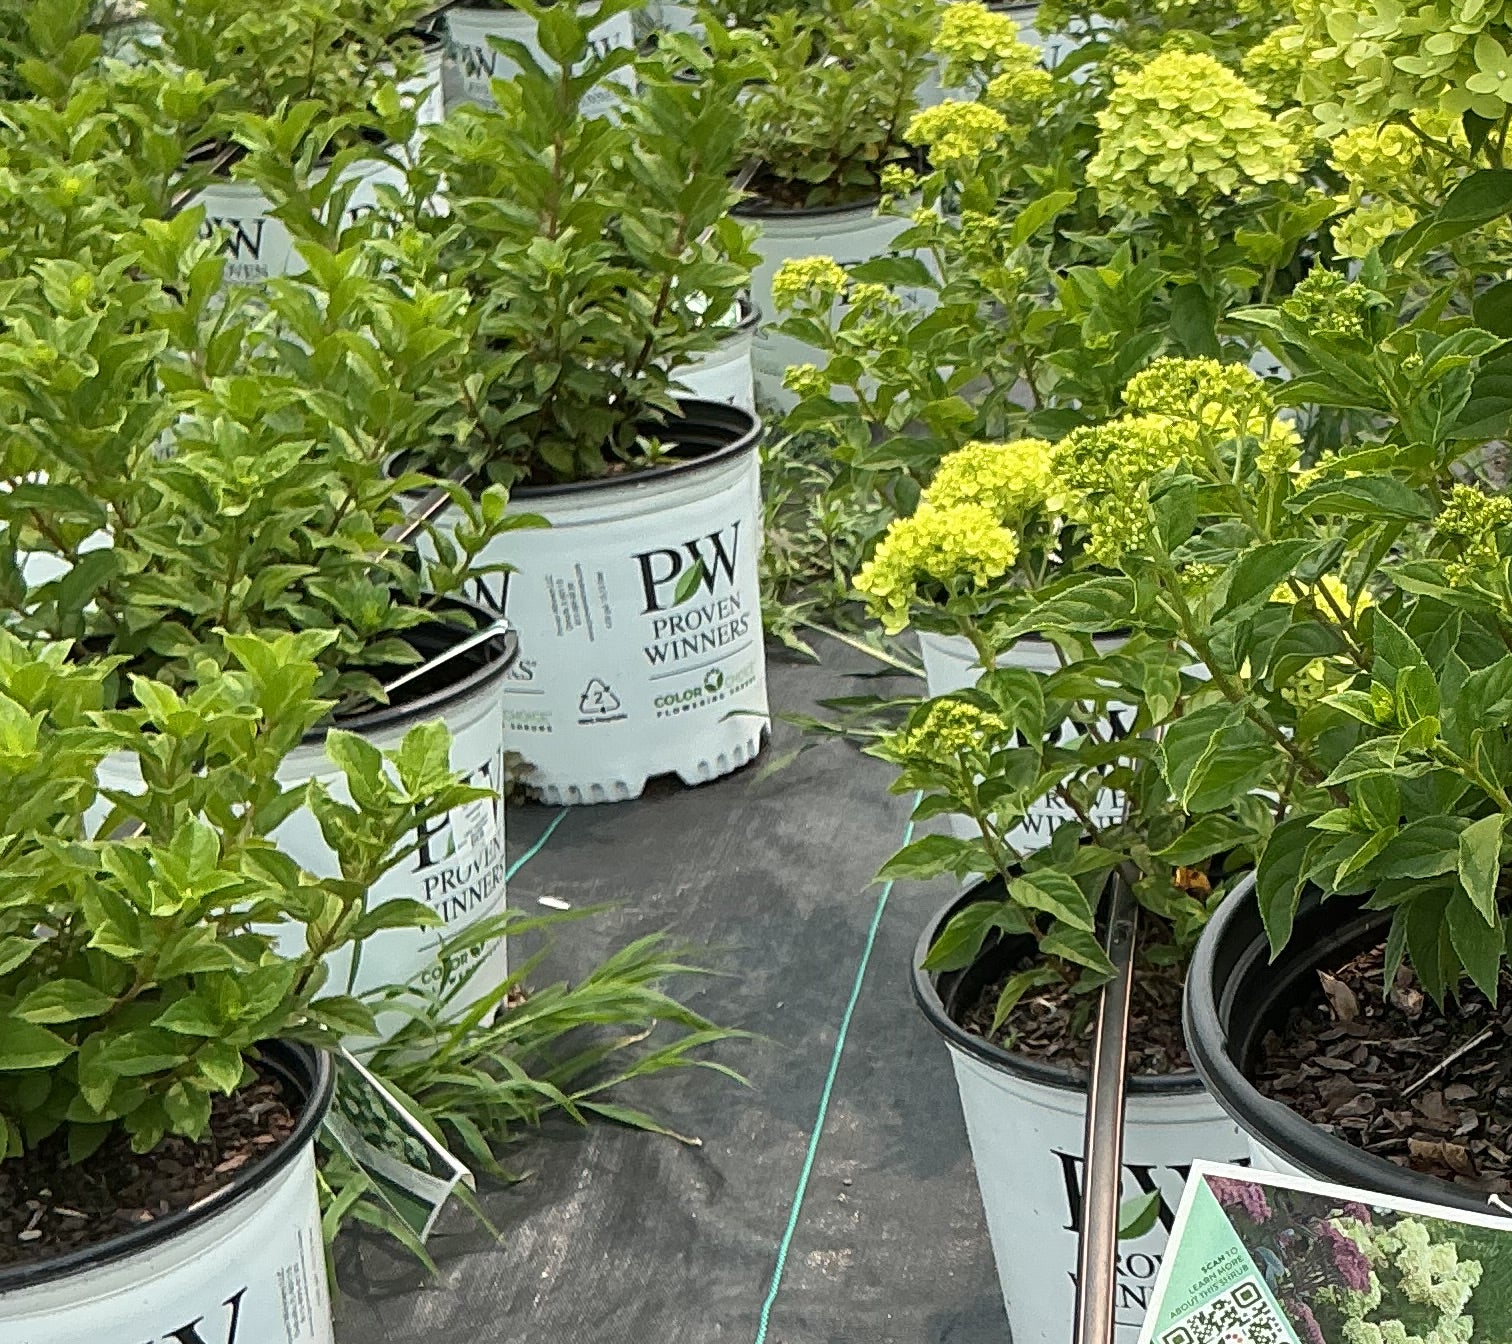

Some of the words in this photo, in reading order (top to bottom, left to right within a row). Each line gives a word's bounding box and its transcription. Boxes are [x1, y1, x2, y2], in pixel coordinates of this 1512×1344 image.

[631, 520, 741, 616] PW
[652, 591, 742, 641] PROVEN
[644, 613, 750, 667] WINNERS
[654, 687, 702, 709] COLOR
[421, 953, 468, 984] COOR
[1189, 1272, 1216, 1294] LEARN
[1217, 1255, 1244, 1275] MORE
[1201, 1254, 1225, 1273] SCAN
[1225, 1247, 1238, 1257] TO
[1170, 1295, 1199, 1319] ABOUT
[1199, 1282, 1219, 1298] THIS
[1219, 1264, 1249, 1286] SHRUB
